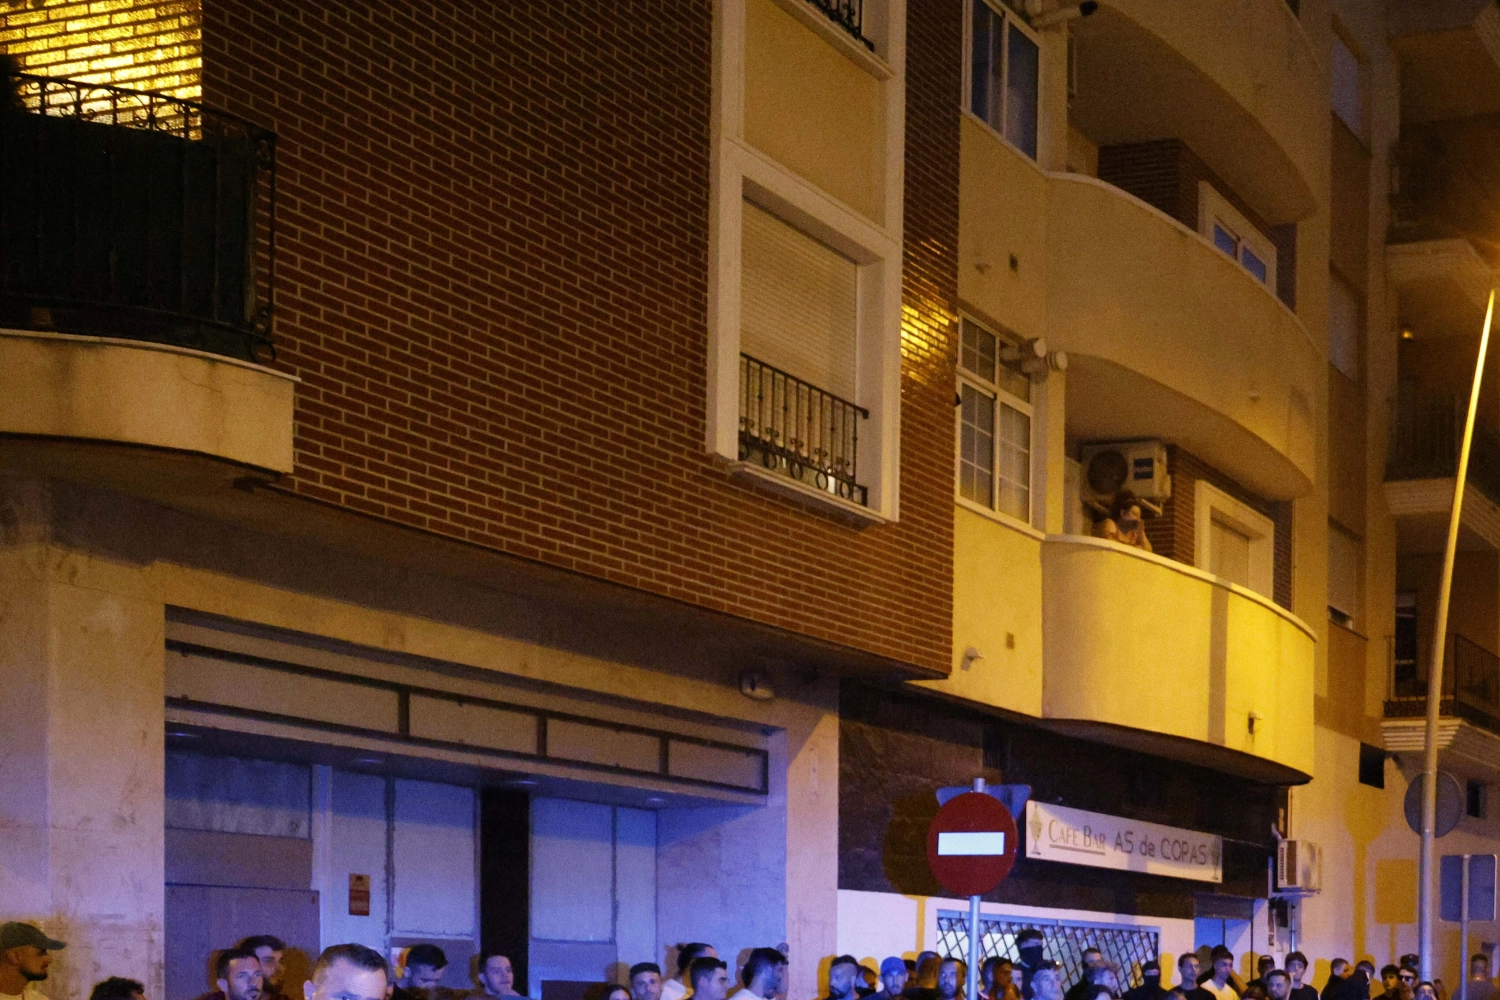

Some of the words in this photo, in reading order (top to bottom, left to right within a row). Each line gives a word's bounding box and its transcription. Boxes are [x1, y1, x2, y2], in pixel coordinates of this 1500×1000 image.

[1113, 831, 1134, 854] AS
[1139, 836, 1155, 857] de
[1160, 838, 1207, 865] COPAS
